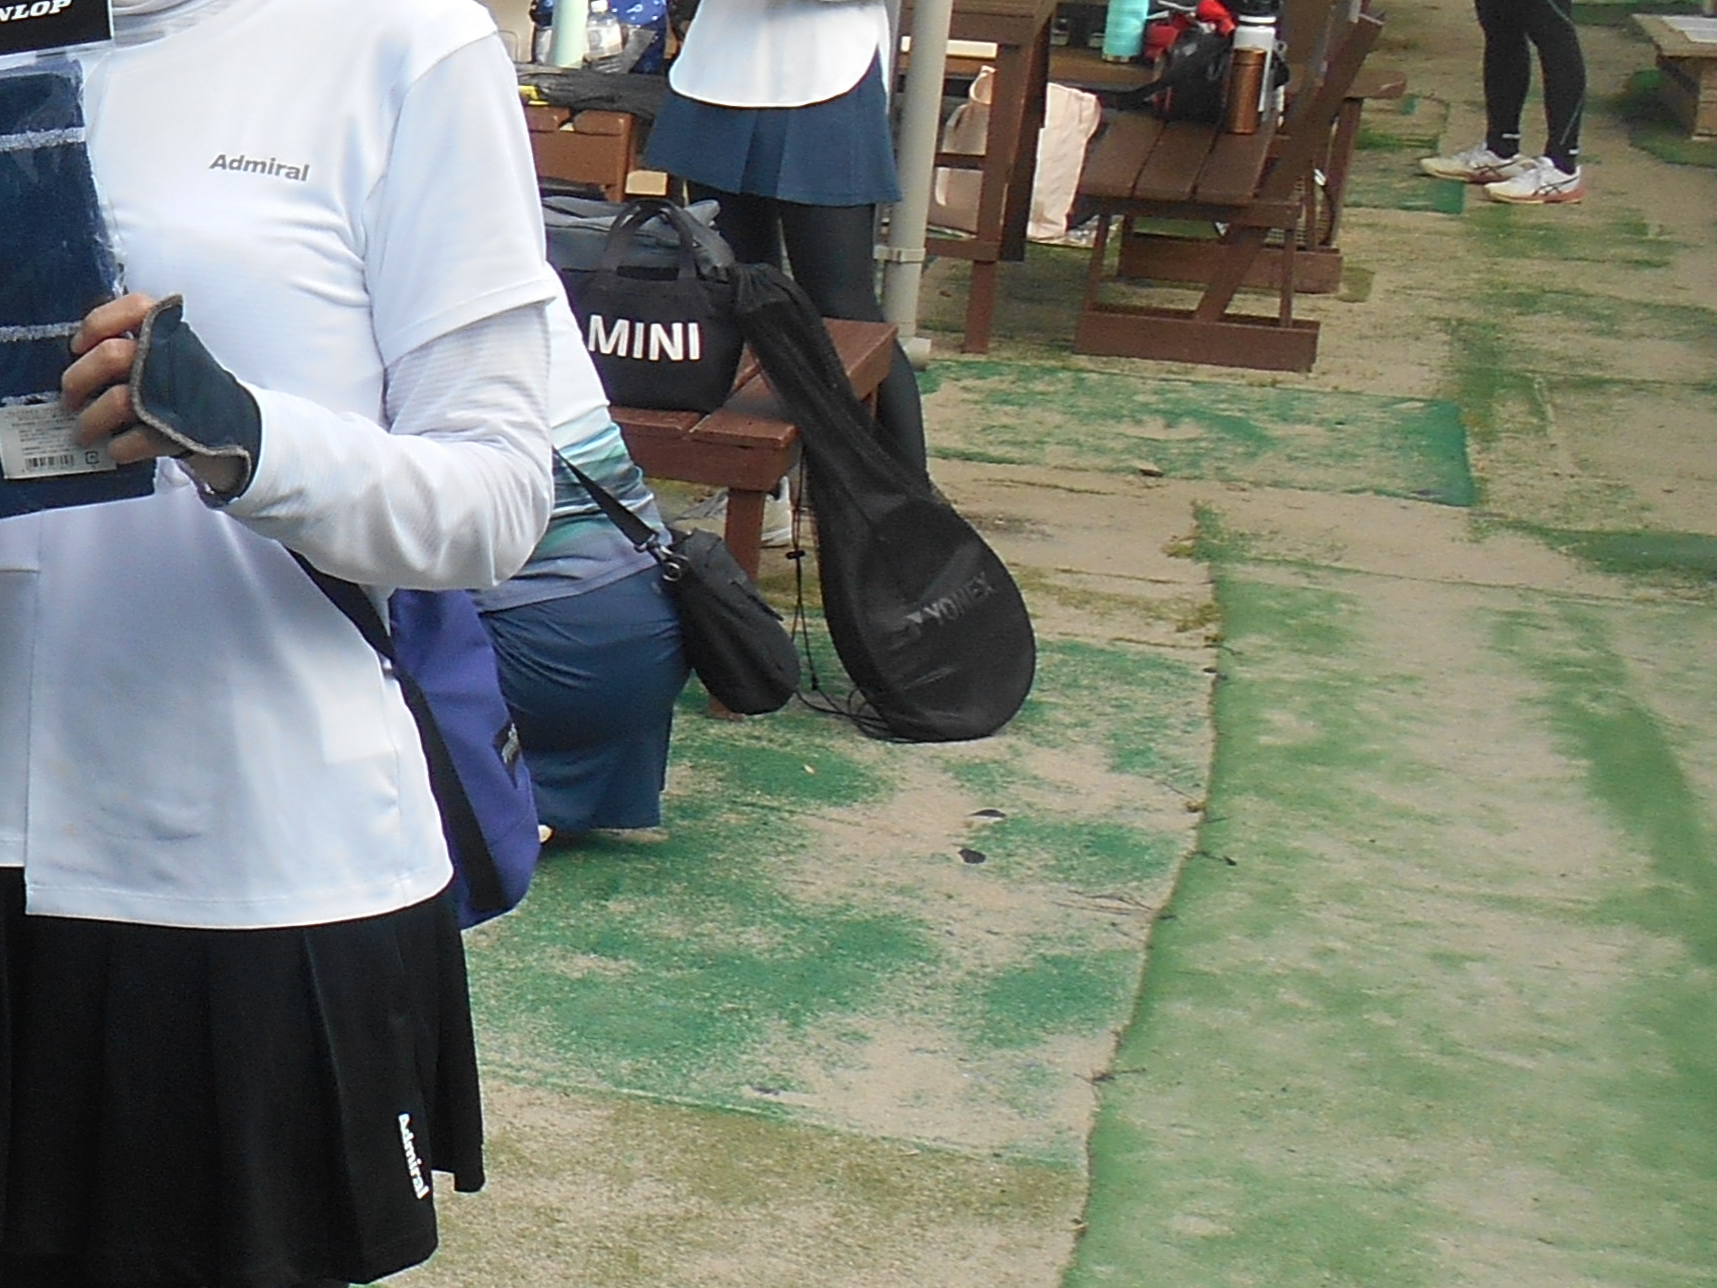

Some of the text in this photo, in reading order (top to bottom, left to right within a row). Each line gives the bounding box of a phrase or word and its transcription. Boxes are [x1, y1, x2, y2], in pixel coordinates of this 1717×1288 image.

[209, 153, 310, 182] Admiral
[587, 314, 701, 362] MINI
[398, 1113, 430, 1200] Admiral
